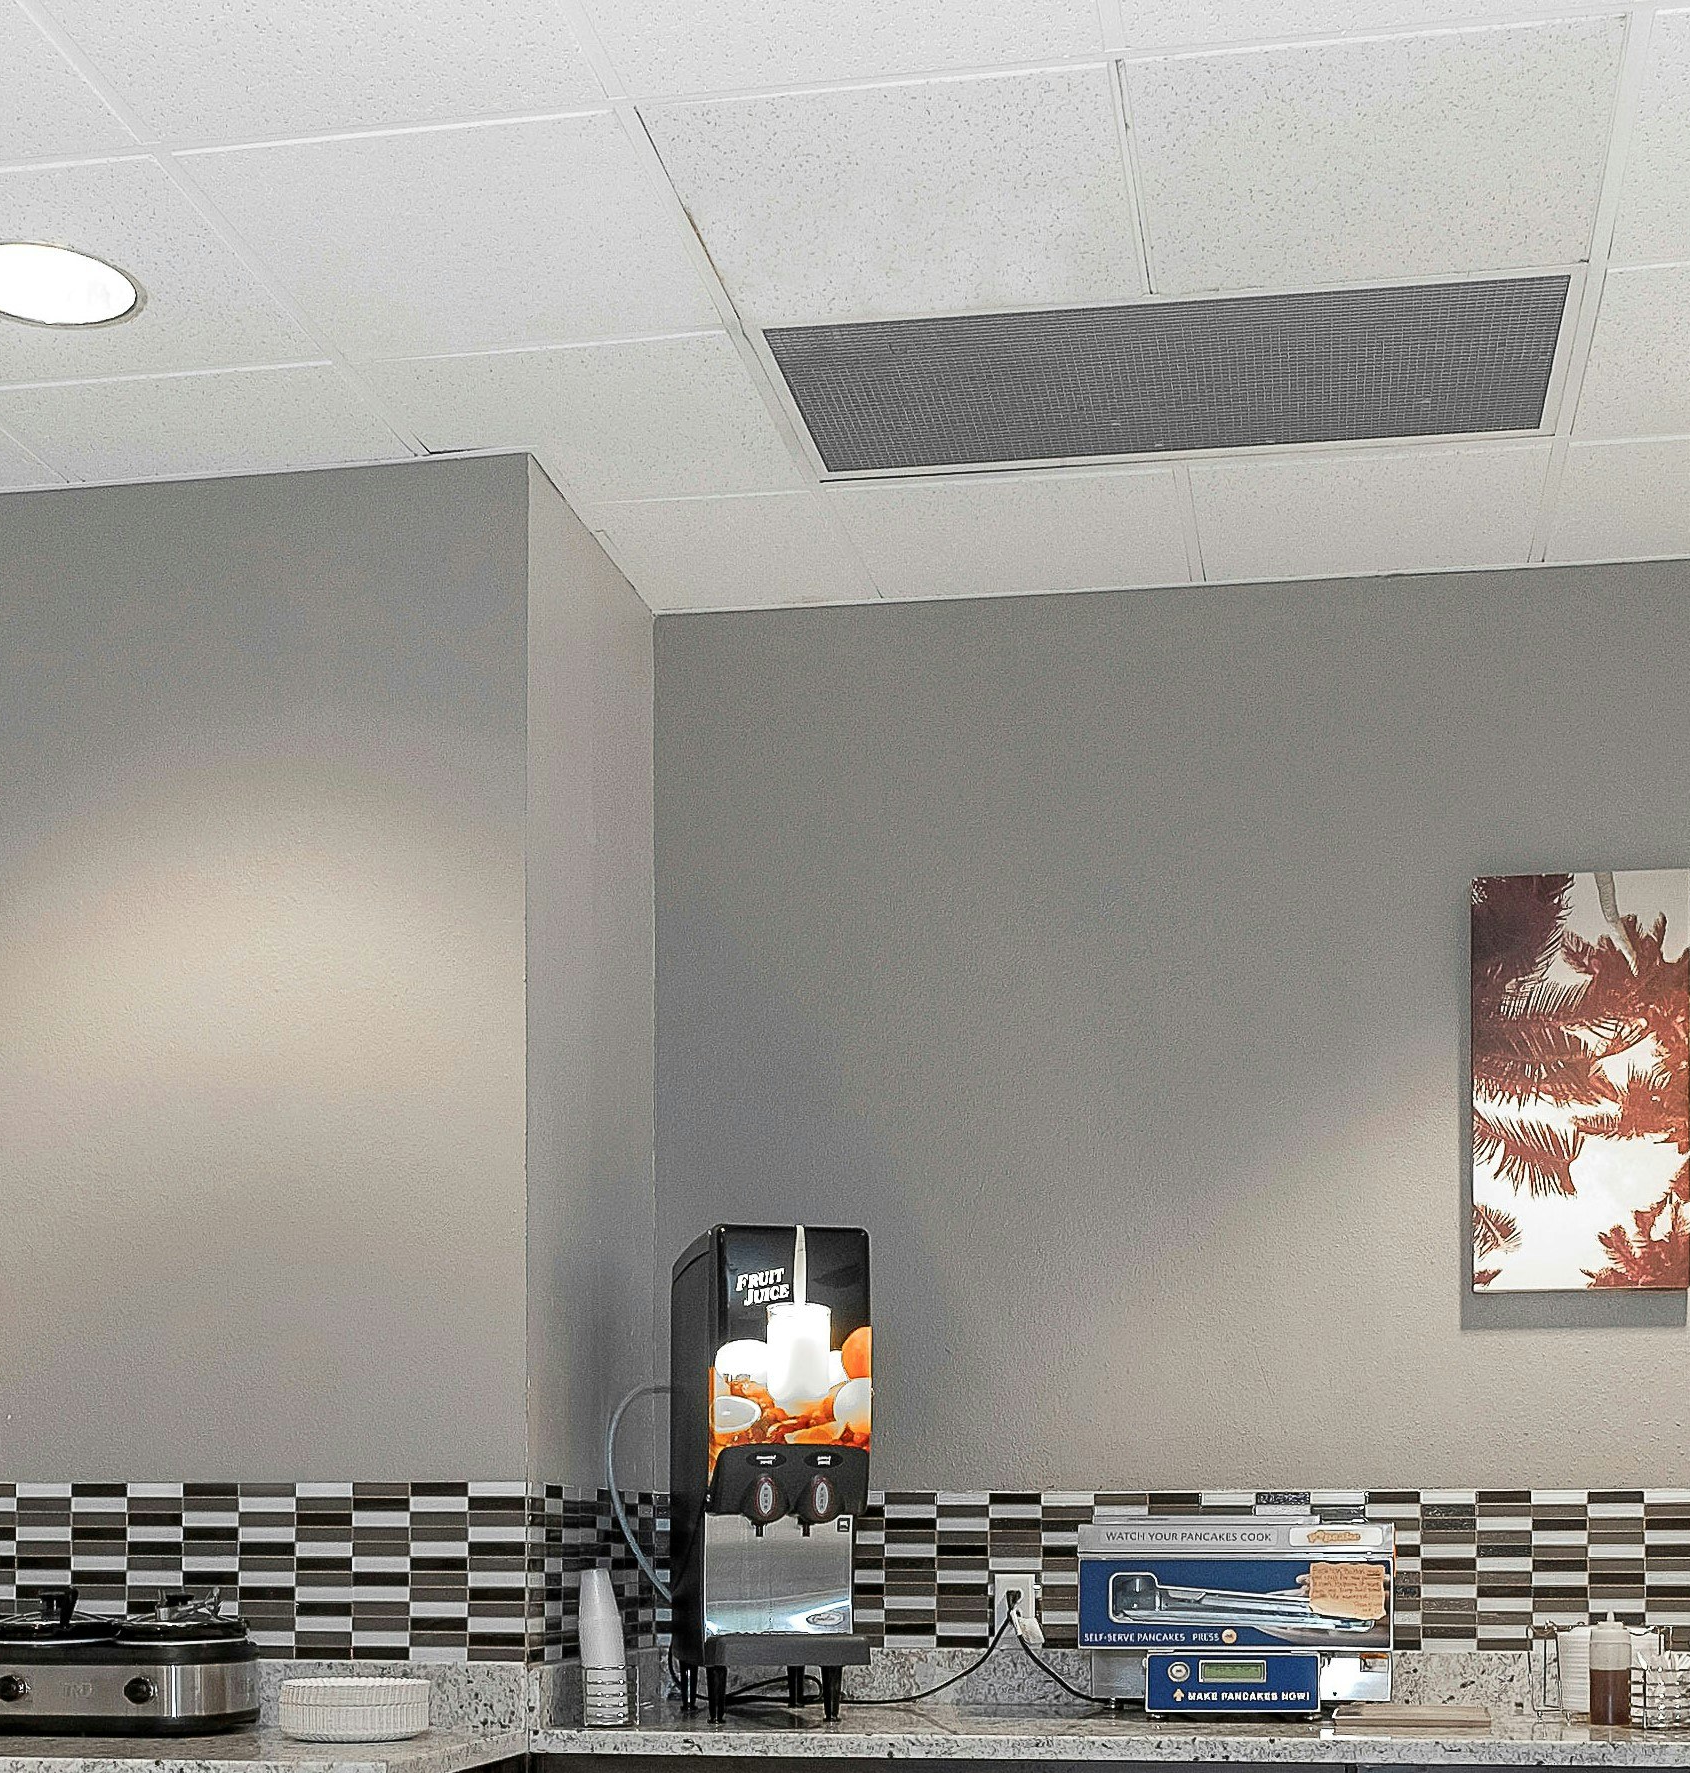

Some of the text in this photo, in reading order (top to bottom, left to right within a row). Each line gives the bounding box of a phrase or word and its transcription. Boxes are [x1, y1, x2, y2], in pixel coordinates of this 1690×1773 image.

[735, 1267, 786, 1292] FRUIT
[743, 1283, 790, 1307] JUICE
[1105, 1531, 1272, 1542] WATCH YOUR PANCAKES COOK
[1084, 1632, 1135, 1642] SELF-SERVE
[1137, 1632, 1186, 1642] PANCAKES
[1192, 1632, 1220, 1642] PRESS
[1187, 1691, 1218, 1701] MAKE
[1221, 1691, 1278, 1701] PANCAKES
